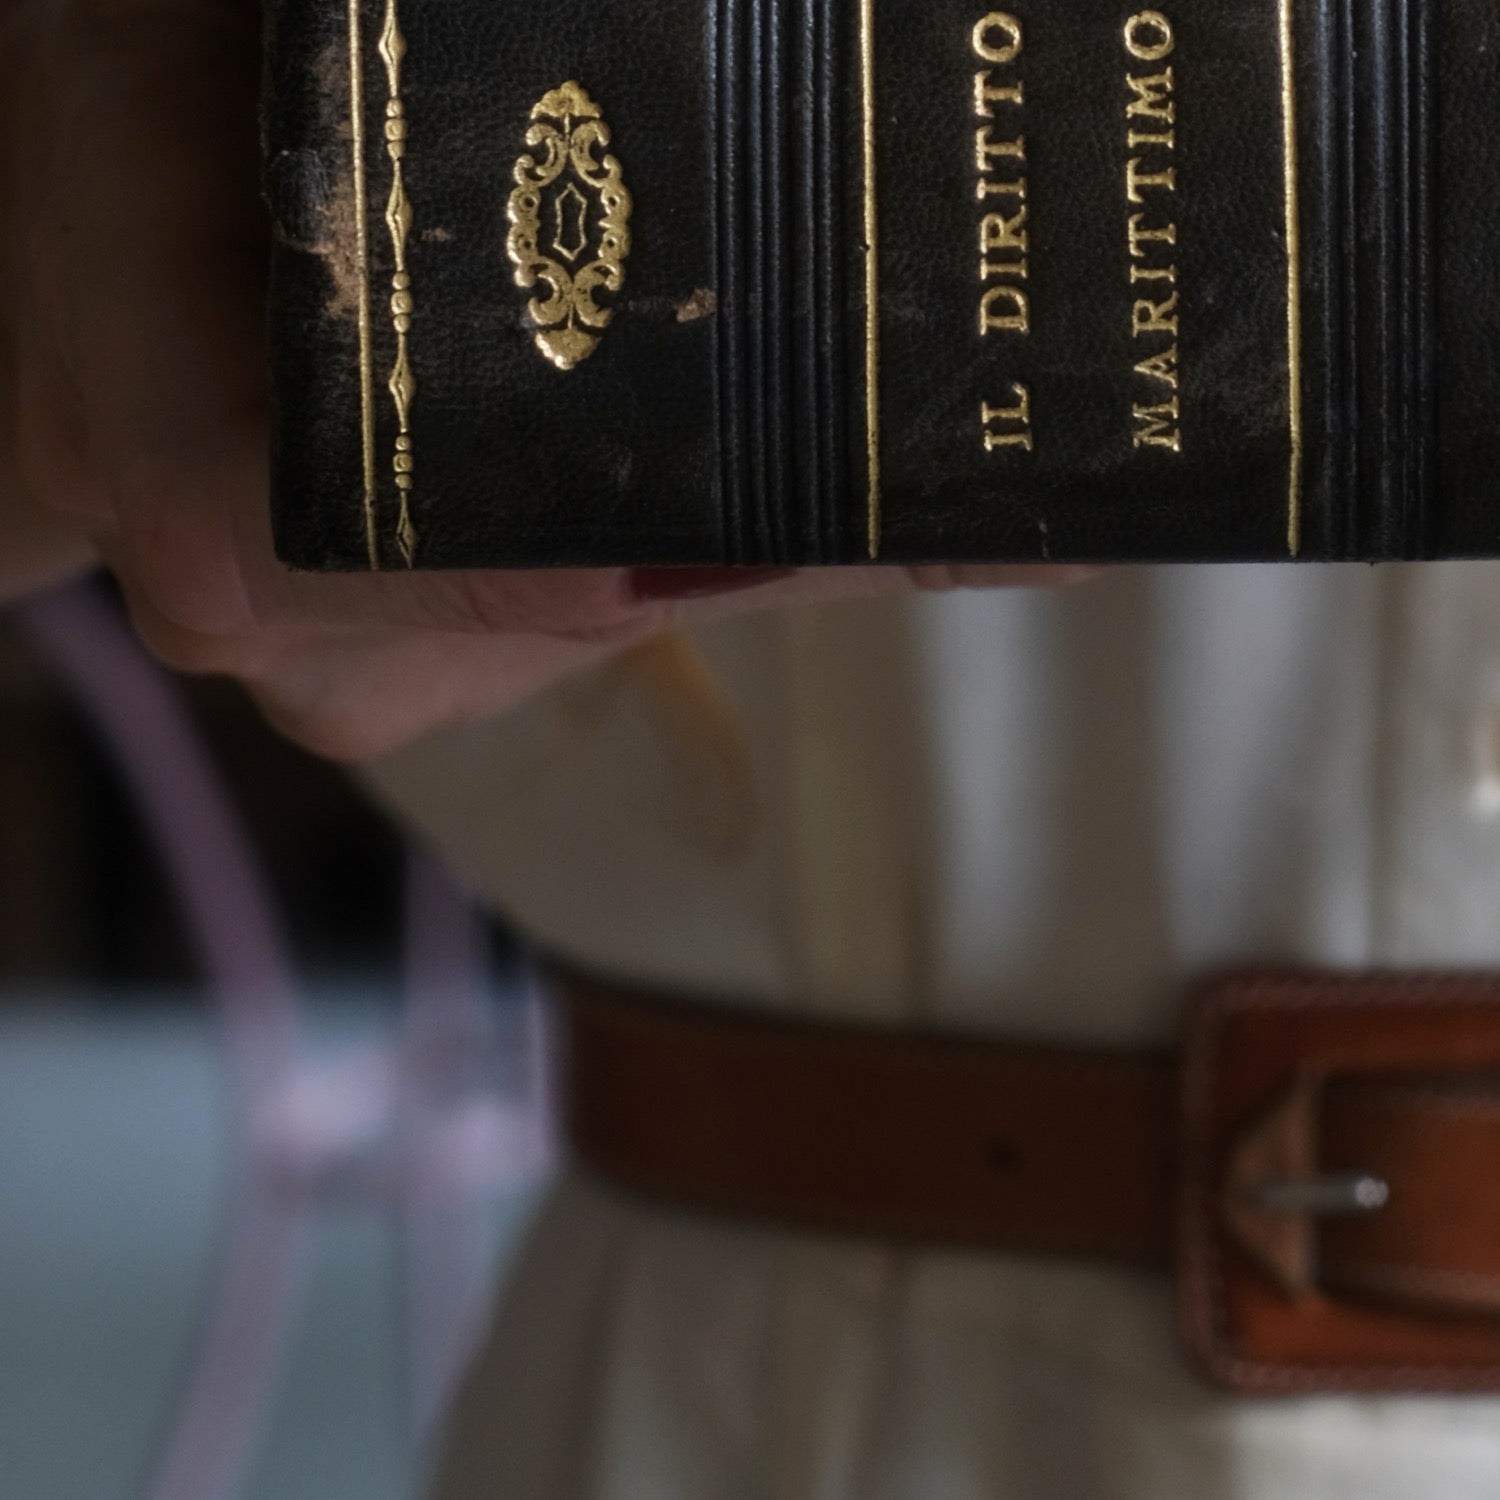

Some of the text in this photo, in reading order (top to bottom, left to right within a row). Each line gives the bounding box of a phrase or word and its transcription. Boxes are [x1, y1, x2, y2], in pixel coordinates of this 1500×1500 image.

[972, 11, 1033, 451] IL DIRITTO
[1124, 9, 1181, 452] MARITTIMO
